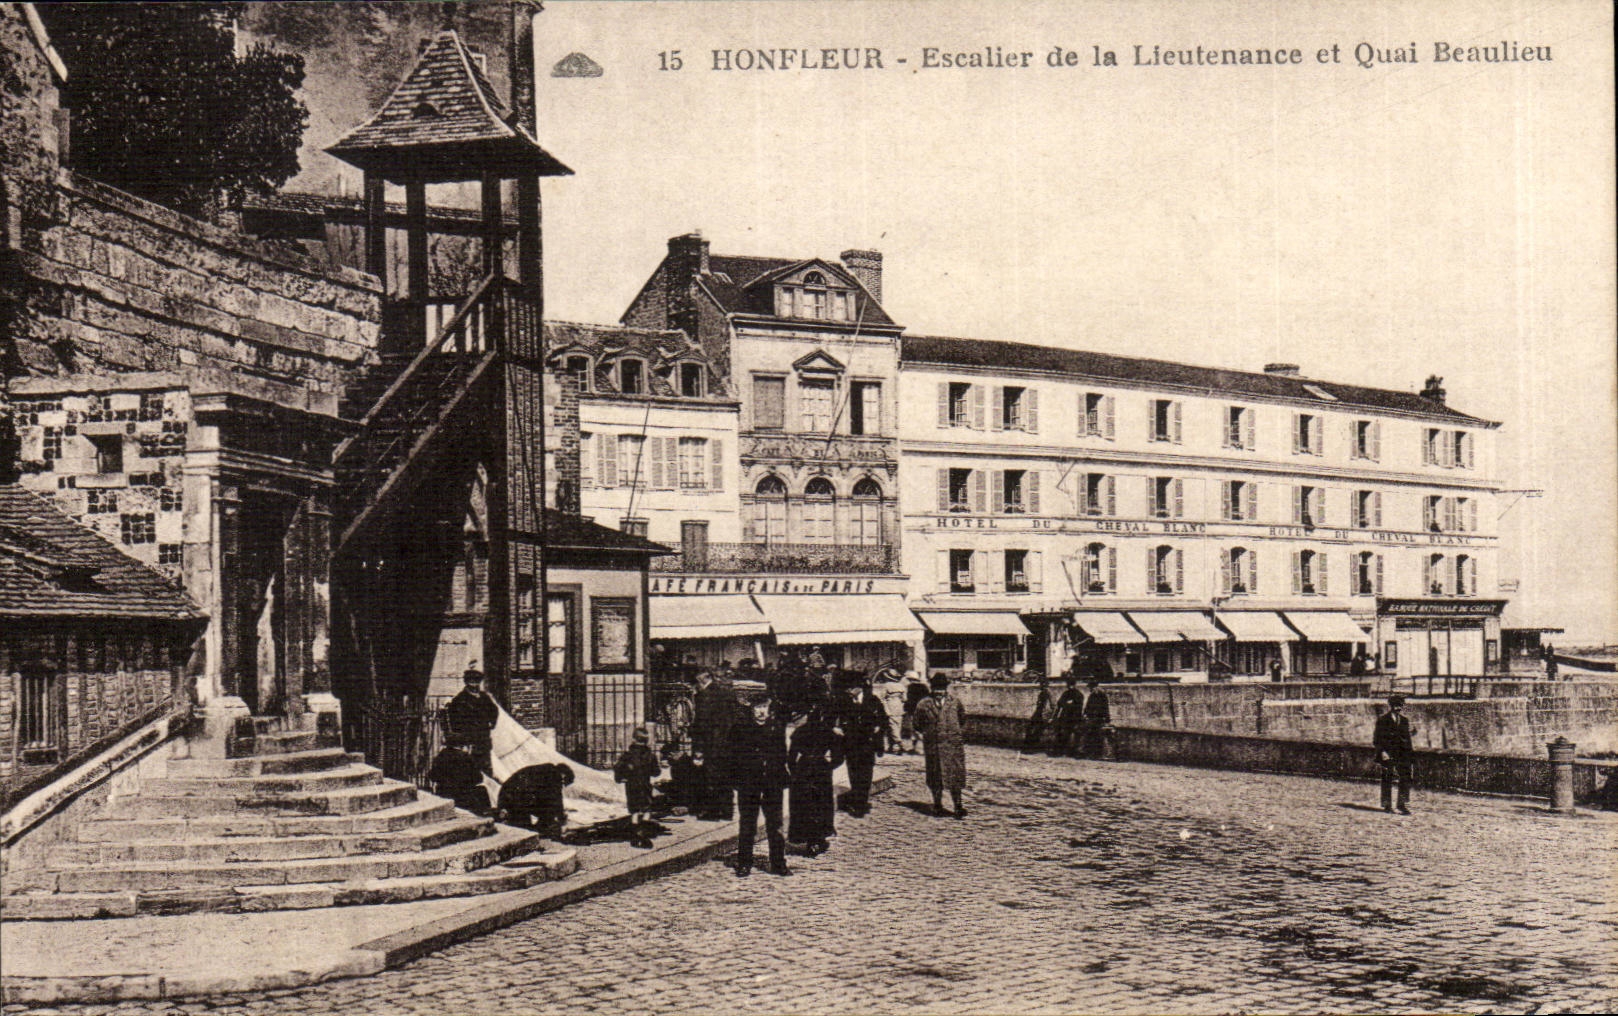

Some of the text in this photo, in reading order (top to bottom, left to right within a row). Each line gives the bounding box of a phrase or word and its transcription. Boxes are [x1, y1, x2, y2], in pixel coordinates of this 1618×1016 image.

[936, 518, 1206, 533] HOTEL DU CHEVAL BLANC
[1269, 527, 1471, 545] HOTEL DU CHEVAL BLANC
[651, 577, 686, 593] AFÉ
[695, 578, 790, 594] FRANÇAIS
[821, 580, 873, 593] PARIS
